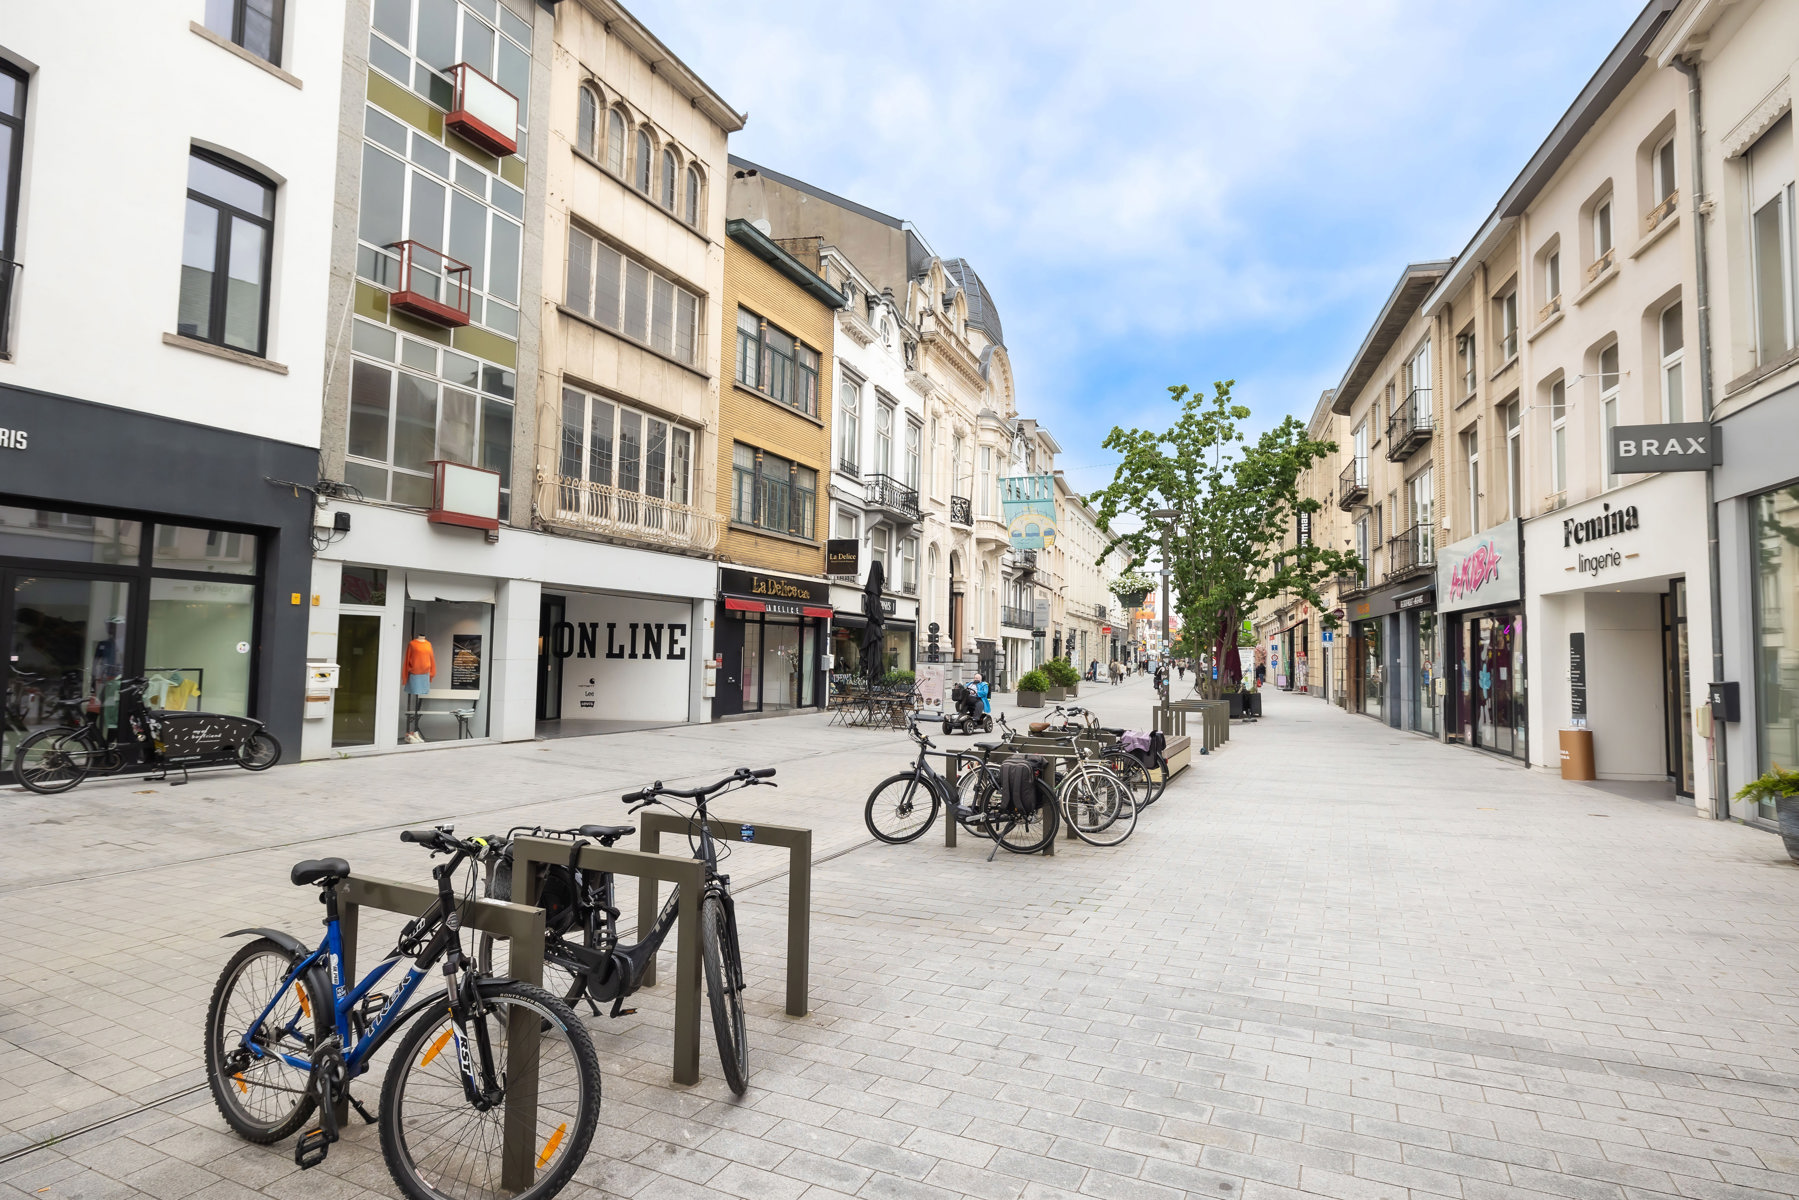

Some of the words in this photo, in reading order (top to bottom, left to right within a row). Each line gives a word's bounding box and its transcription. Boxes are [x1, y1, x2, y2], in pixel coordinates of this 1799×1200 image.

[1618, 437, 1707, 457] BRAX
[1563, 502, 1640, 548] Femina
[838, 552, 857, 560] Delice
[1578, 547, 1621, 577] lingerie
[752, 576, 767, 594] La
[767, 578, 798, 597] Delice
[1450, 540, 1502, 603] AKIBA
[766, 604, 772, 612] LA
[773, 604, 799, 614] DELICE
[365, 974, 412, 1038] TREK
[459, 1036, 473, 1076] RST
